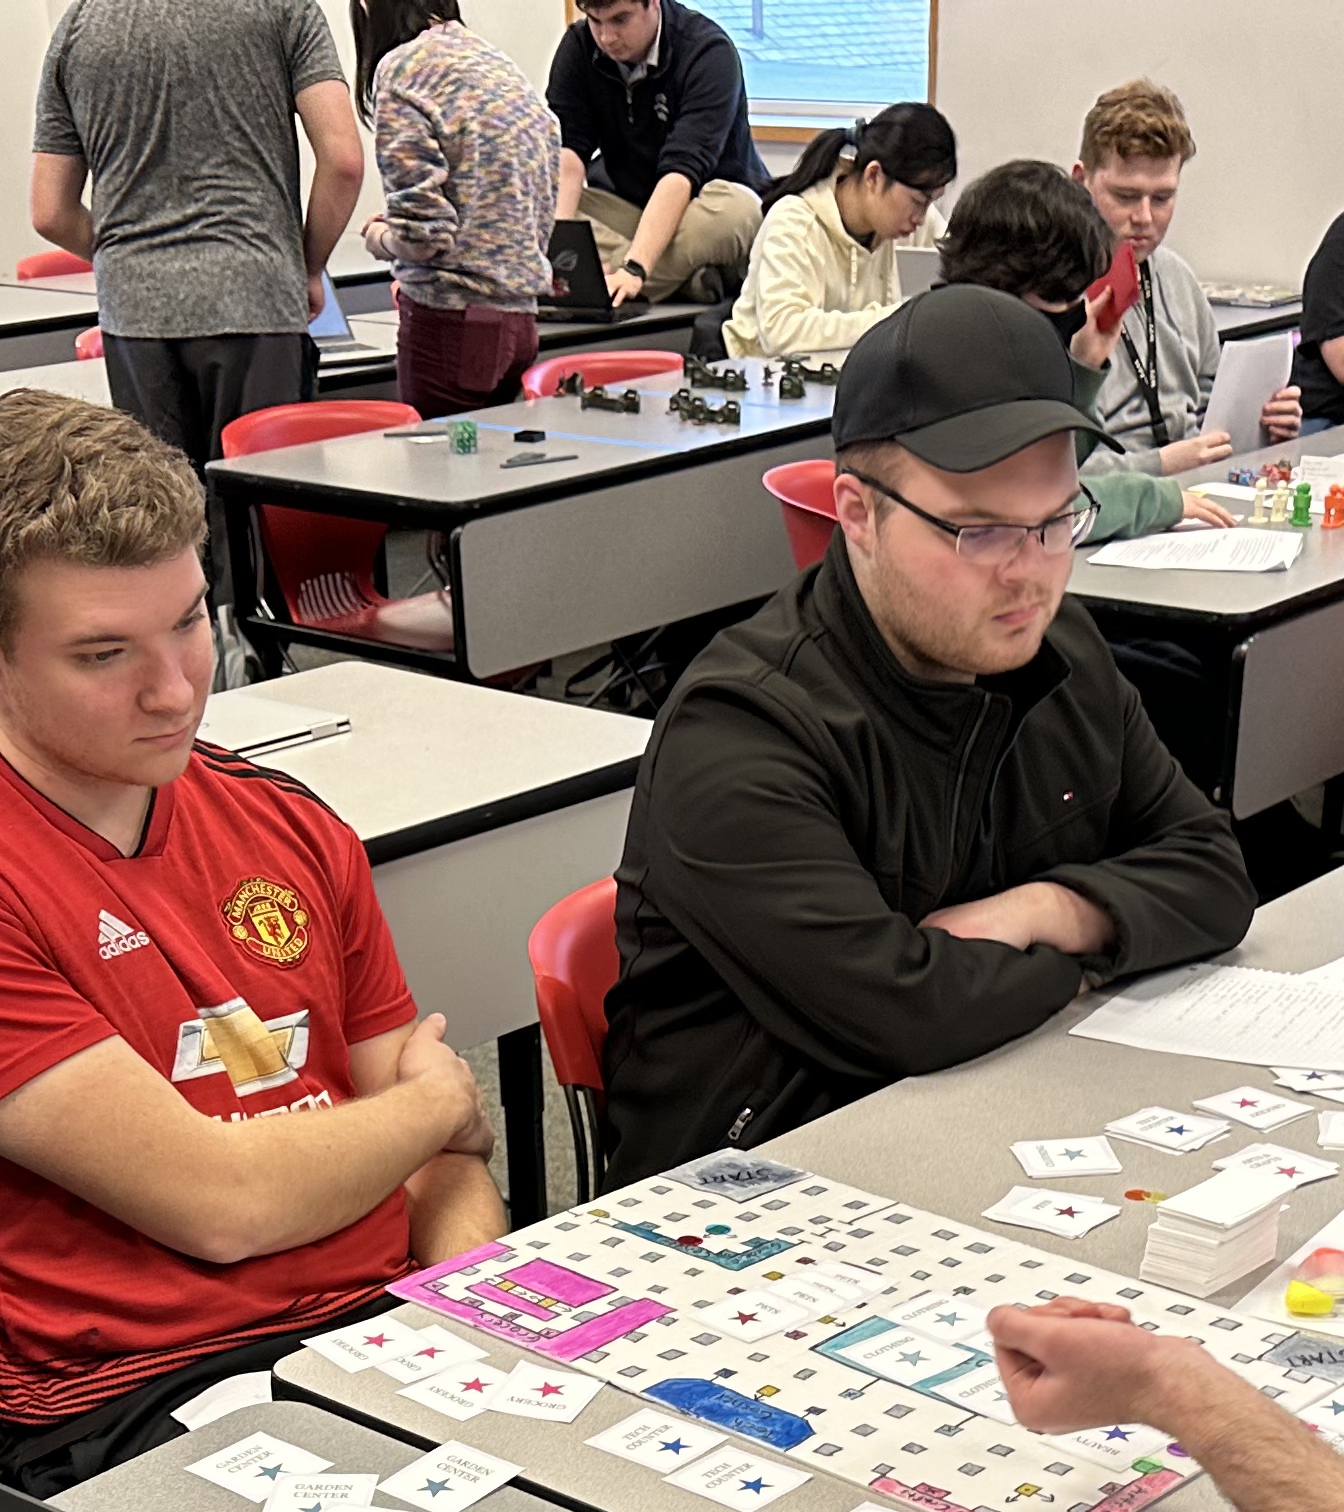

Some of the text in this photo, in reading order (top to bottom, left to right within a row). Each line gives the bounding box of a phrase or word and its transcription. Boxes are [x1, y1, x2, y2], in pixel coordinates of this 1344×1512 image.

[233, 882, 293, 919] MANCHESTER
[98, 931, 151, 960] adidas
[262, 937, 305, 958] UNITED
[793, 1291, 819, 1303] PETS
[755, 1302, 782, 1315] PETS
[901, 1298, 950, 1321] CLOTHING
[332, 1338, 369, 1361] GROCERY
[863, 1336, 915, 1359] CLOTHING
[428, 1386, 474, 1408] GROCERY
[958, 1374, 1002, 1399] CLOTHIN
[508, 1396, 567, 1410] GROCERY
[622, 1424, 652, 1441] TECH
[625, 1424, 673, 1451] COUNTER
[216, 1444, 264, 1469] GARDEN
[1073, 1436, 1121, 1456] BEAUTY
[227, 1450, 274, 1474] CENTER
[436, 1462, 480, 1483] CENTER
[446, 1455, 495, 1476] GARDEN
[701, 1462, 732, 1478] TECH
[705, 1462, 755, 1489] COUNTER
